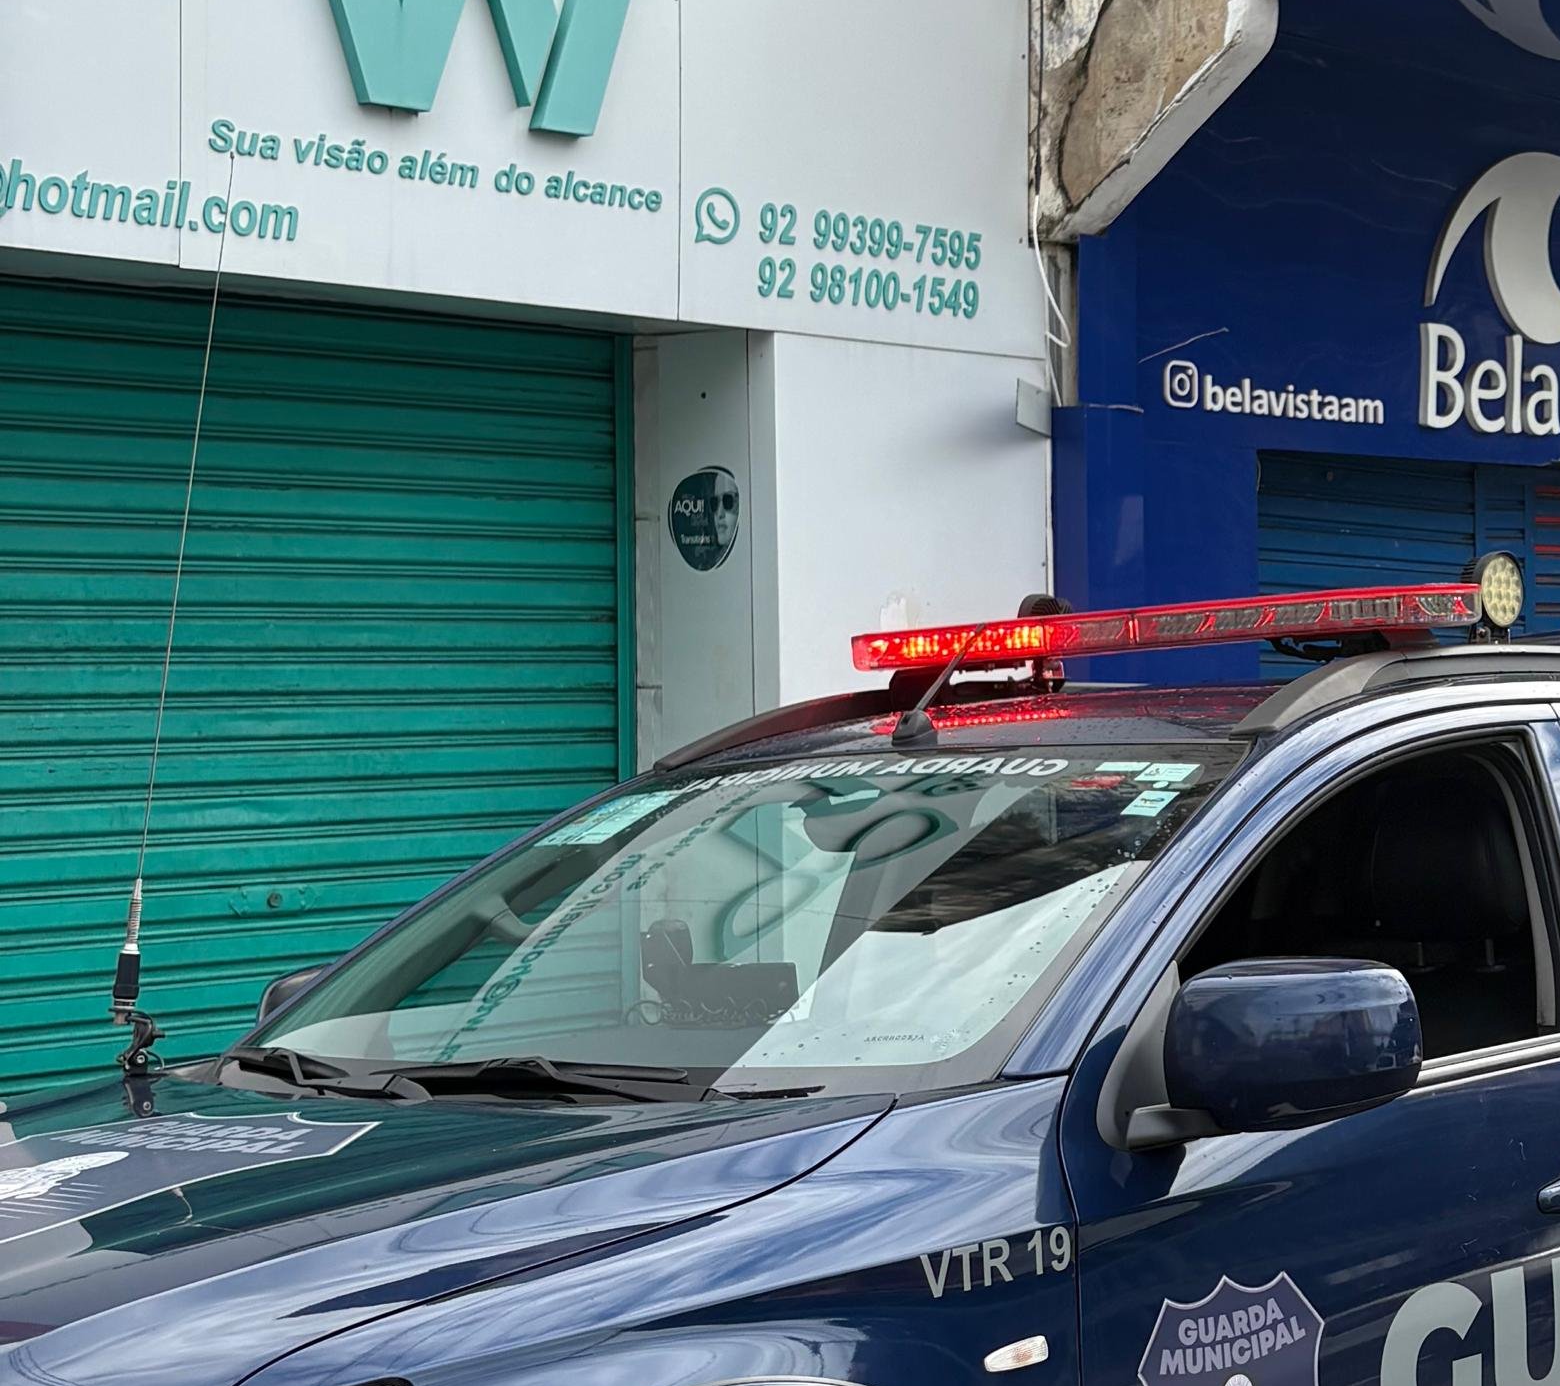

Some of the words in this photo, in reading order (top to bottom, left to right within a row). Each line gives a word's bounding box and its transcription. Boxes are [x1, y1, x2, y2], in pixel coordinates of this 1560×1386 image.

[208, 118, 283, 163] Sua
[293, 131, 389, 176] visão
[398, 148, 479, 189] além
[493, 159, 534, 196] do
[544, 170, 664, 213] alcance
[758, 202, 798, 245] 92
[812, 207, 983, 271] 99399-7595
[757, 255, 797, 299] 92
[809, 259, 981, 320] 98100-1549
[1203, 372, 1385, 426] belavistaam
[50, 1130, 305, 1154] MUNICIPAL
[128, 1121, 313, 1141] GUARDA
[920, 1238, 1012, 1299] VTR
[1026, 1224, 1072, 1277] 19
[1159, 1315, 1307, 1376] MUNICIPAL
[1178, 1298, 1285, 1347] GUARDA
